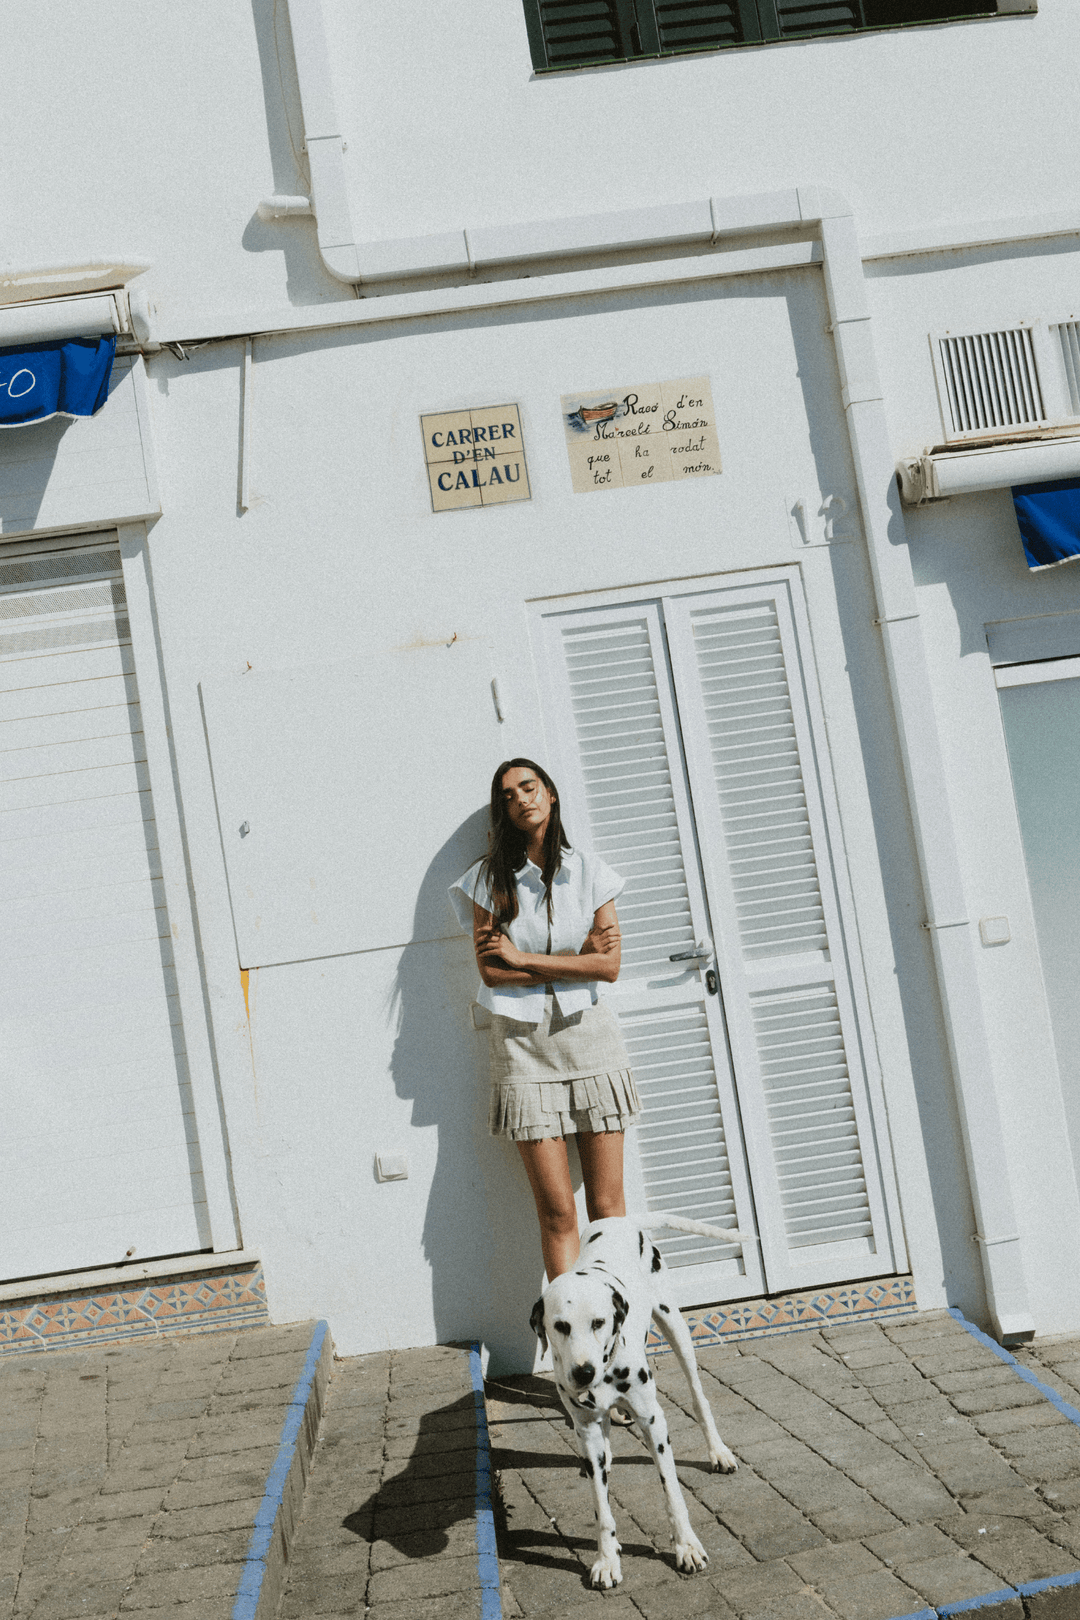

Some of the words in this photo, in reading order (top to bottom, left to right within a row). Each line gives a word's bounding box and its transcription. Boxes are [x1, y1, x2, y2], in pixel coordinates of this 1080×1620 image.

[676, 394, 704, 409] d'en
[431, 423, 516, 448] CARRER
[452, 446, 496, 465] D'EN
[587, 454, 611, 471] que
[635, 445, 650, 458] ha
[670, 435, 707, 454] rodat
[437, 463, 521, 492] CALAU
[593, 468, 612, 485] tot
[641, 465, 655, 479] el
